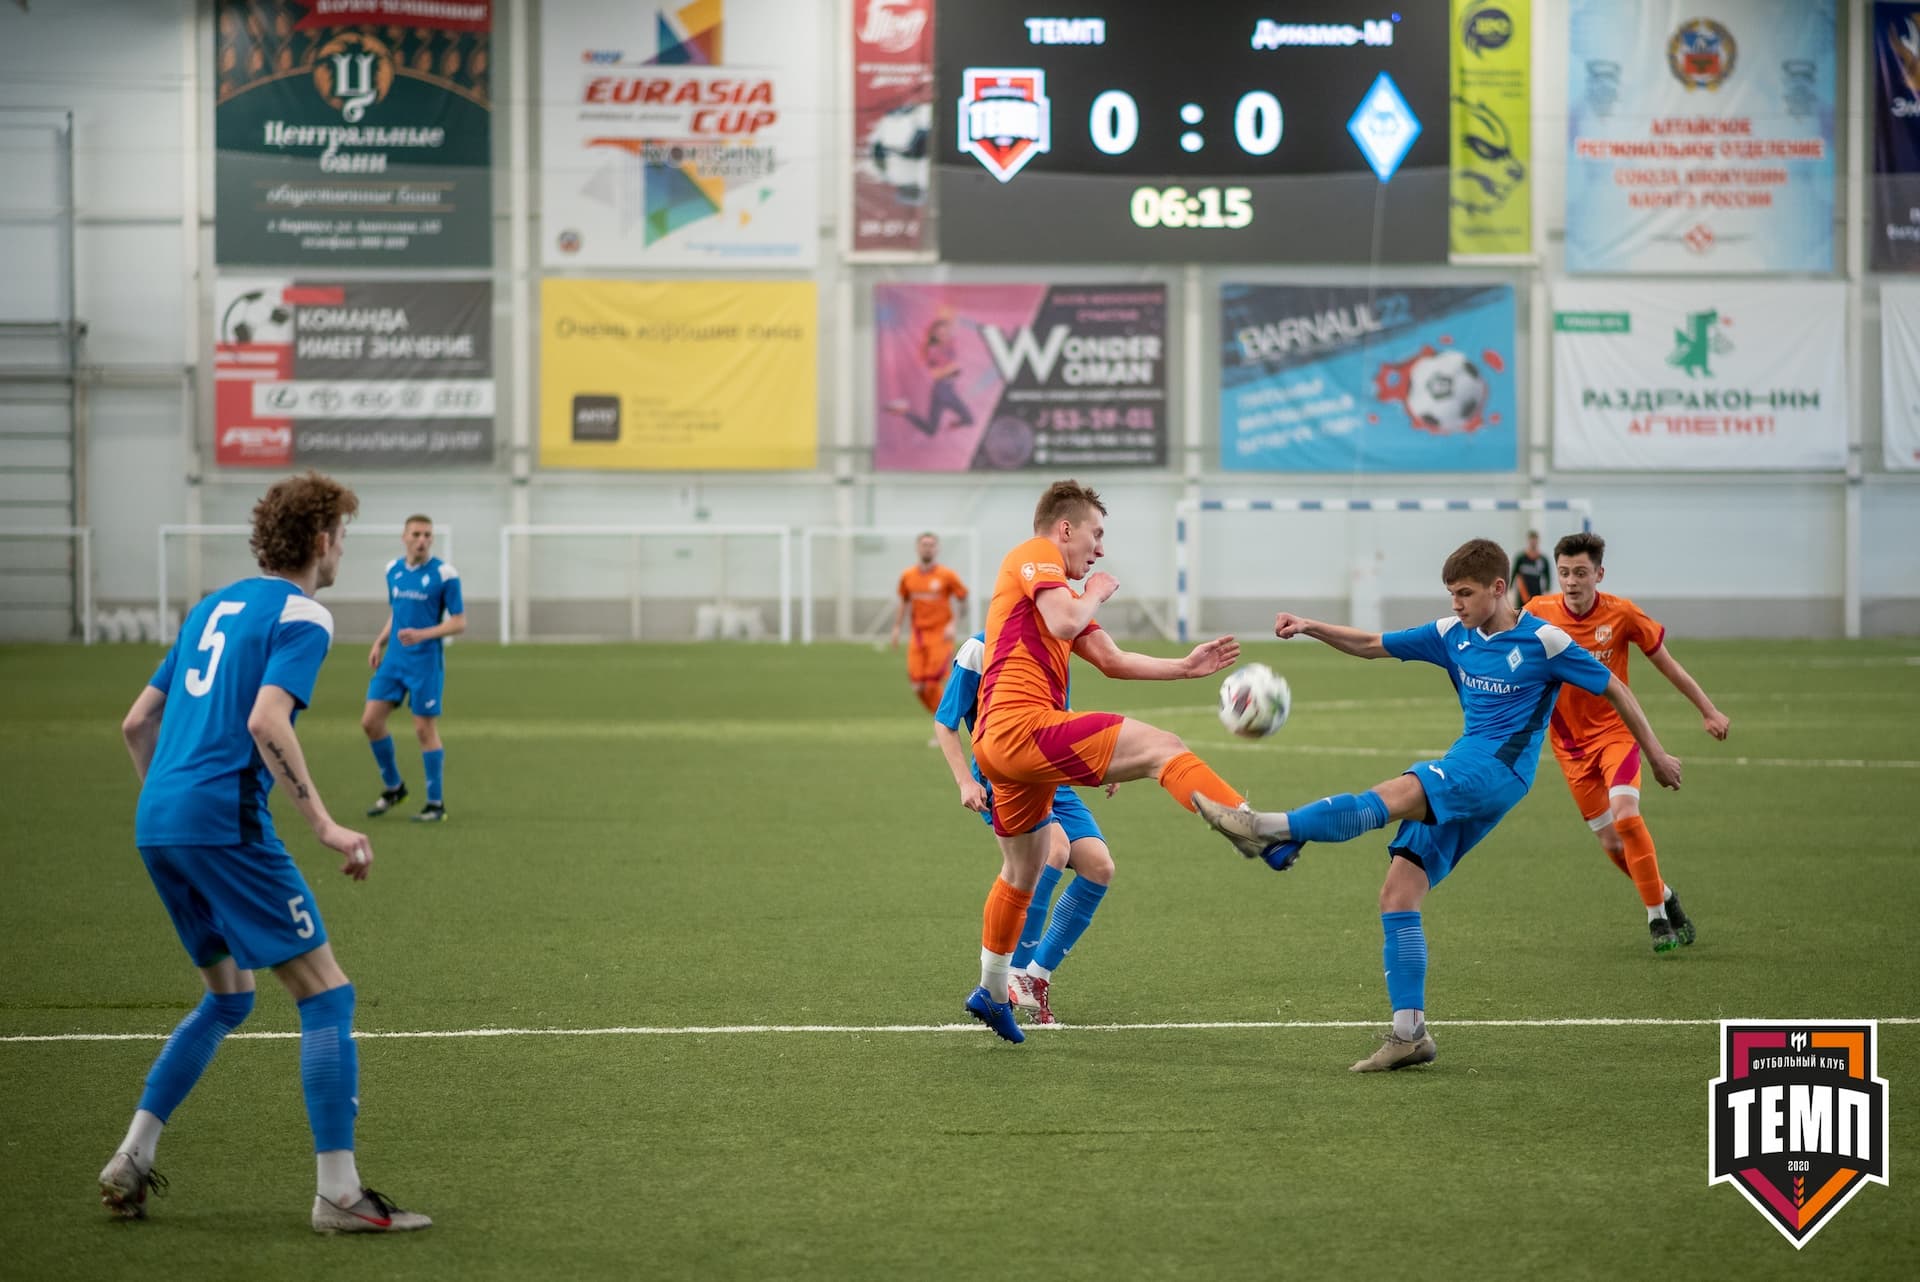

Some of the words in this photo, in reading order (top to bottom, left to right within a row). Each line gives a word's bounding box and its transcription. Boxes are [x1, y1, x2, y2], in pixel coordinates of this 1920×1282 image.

[1025, 19, 1105, 44] ТЕМП
[1251, 20, 1393, 50] Динамо-М
[583, 77, 775, 105] EURASIA
[263, 120, 446, 149] Центральные
[690, 109, 778, 135] CUP
[1090, 91, 1138, 155] 0
[1234, 91, 1283, 155] 0
[1576, 140, 1715, 159] РЕГИОНАЛЬНОЕ
[1720, 139, 1824, 159] ОТДЕЛЕНИЕ
[1130, 188, 1253, 228] 06:15
[299, 308, 409, 332] КОМАНДА
[299, 336, 365, 358] ИМЕЕТ
[369, 335, 474, 359] ЗНАЧЕНИЕ
[185, 600, 247, 697] 5
[288, 895, 315, 939] 5
